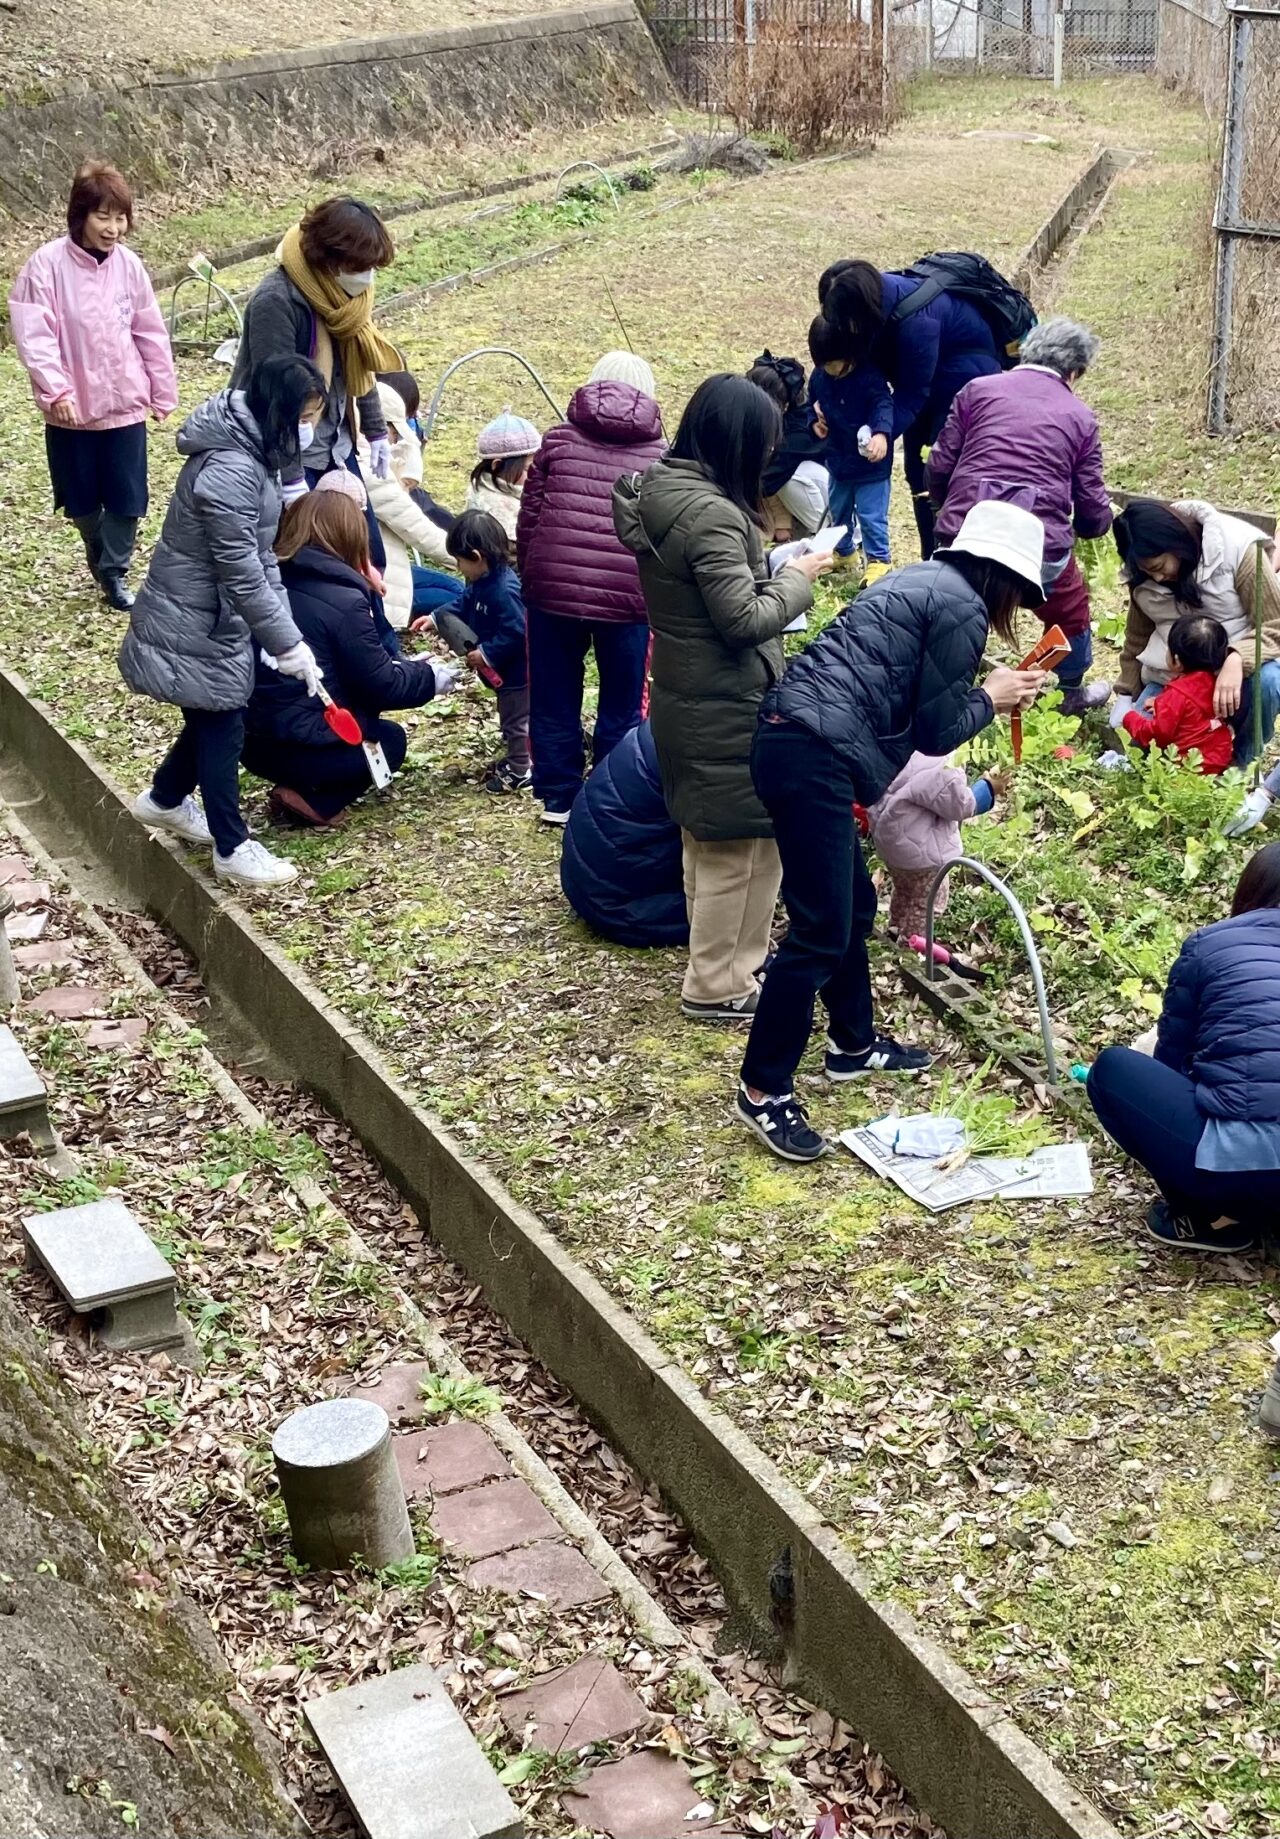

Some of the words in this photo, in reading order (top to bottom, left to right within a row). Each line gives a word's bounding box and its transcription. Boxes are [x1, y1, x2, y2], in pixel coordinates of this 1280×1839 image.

[864, 1051, 890, 1068] N
[755, 1112, 777, 1132] N
[1173, 1215, 1195, 1238] N
